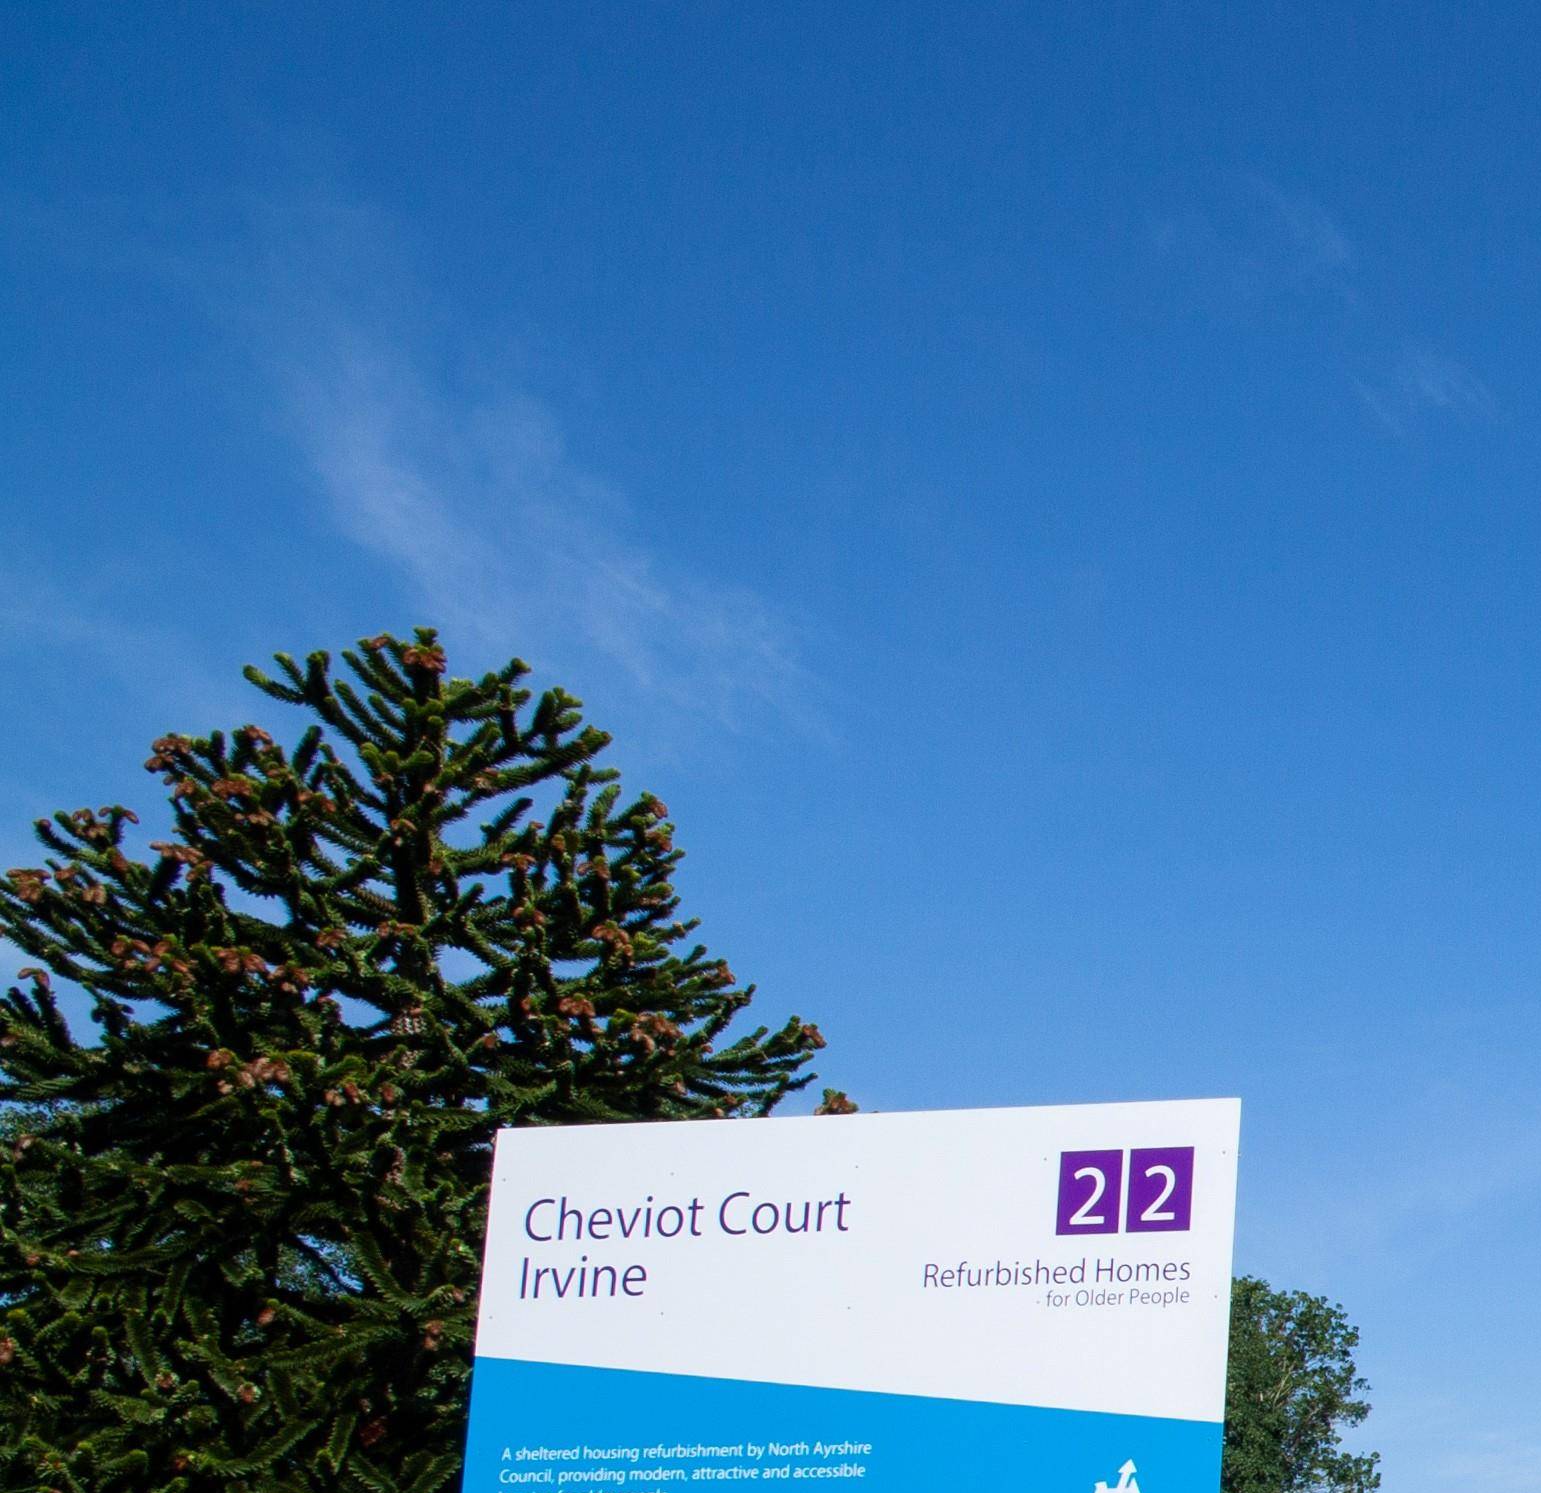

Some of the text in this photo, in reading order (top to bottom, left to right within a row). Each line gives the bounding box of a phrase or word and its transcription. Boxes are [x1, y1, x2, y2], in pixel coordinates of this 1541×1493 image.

[525, 1192, 851, 1241] Cheviot Court
[520, 1256, 646, 1299] Irvine
[924, 1258, 1190, 1287] Refurbished Homes
[1047, 1287, 1189, 1308] for Older People
[501, 1440, 872, 1463] A sheltered housing refurbishment by North Ayrshire
[498, 1463, 866, 1485] Council, providing modern, attractive and accessible
